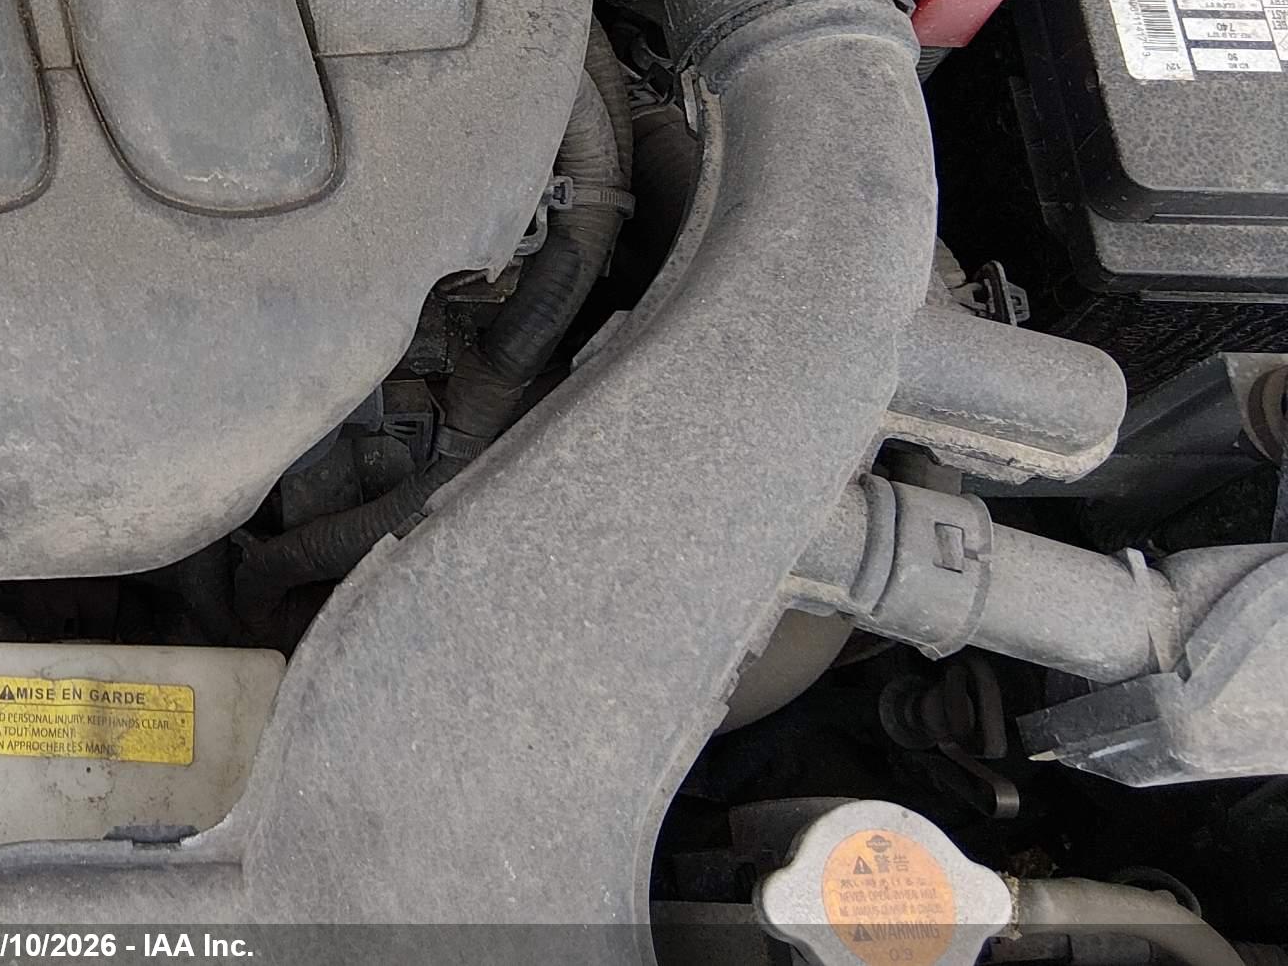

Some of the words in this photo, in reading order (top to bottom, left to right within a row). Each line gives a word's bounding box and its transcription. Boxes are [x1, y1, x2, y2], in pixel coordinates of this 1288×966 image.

[1216, 22, 1236, 32] 740
[16, 687, 55, 699] MISE
[62, 688, 82, 700] EN
[90, 690, 146, 705] GARDE
[8, 713, 53, 724] PERSONAL
[4, 726, 28, 737] TOUT
[7, 740, 64, 752] APPROCHER
[67, 742, 83, 753] LES
[871, 919, 940, 940] WARNING
